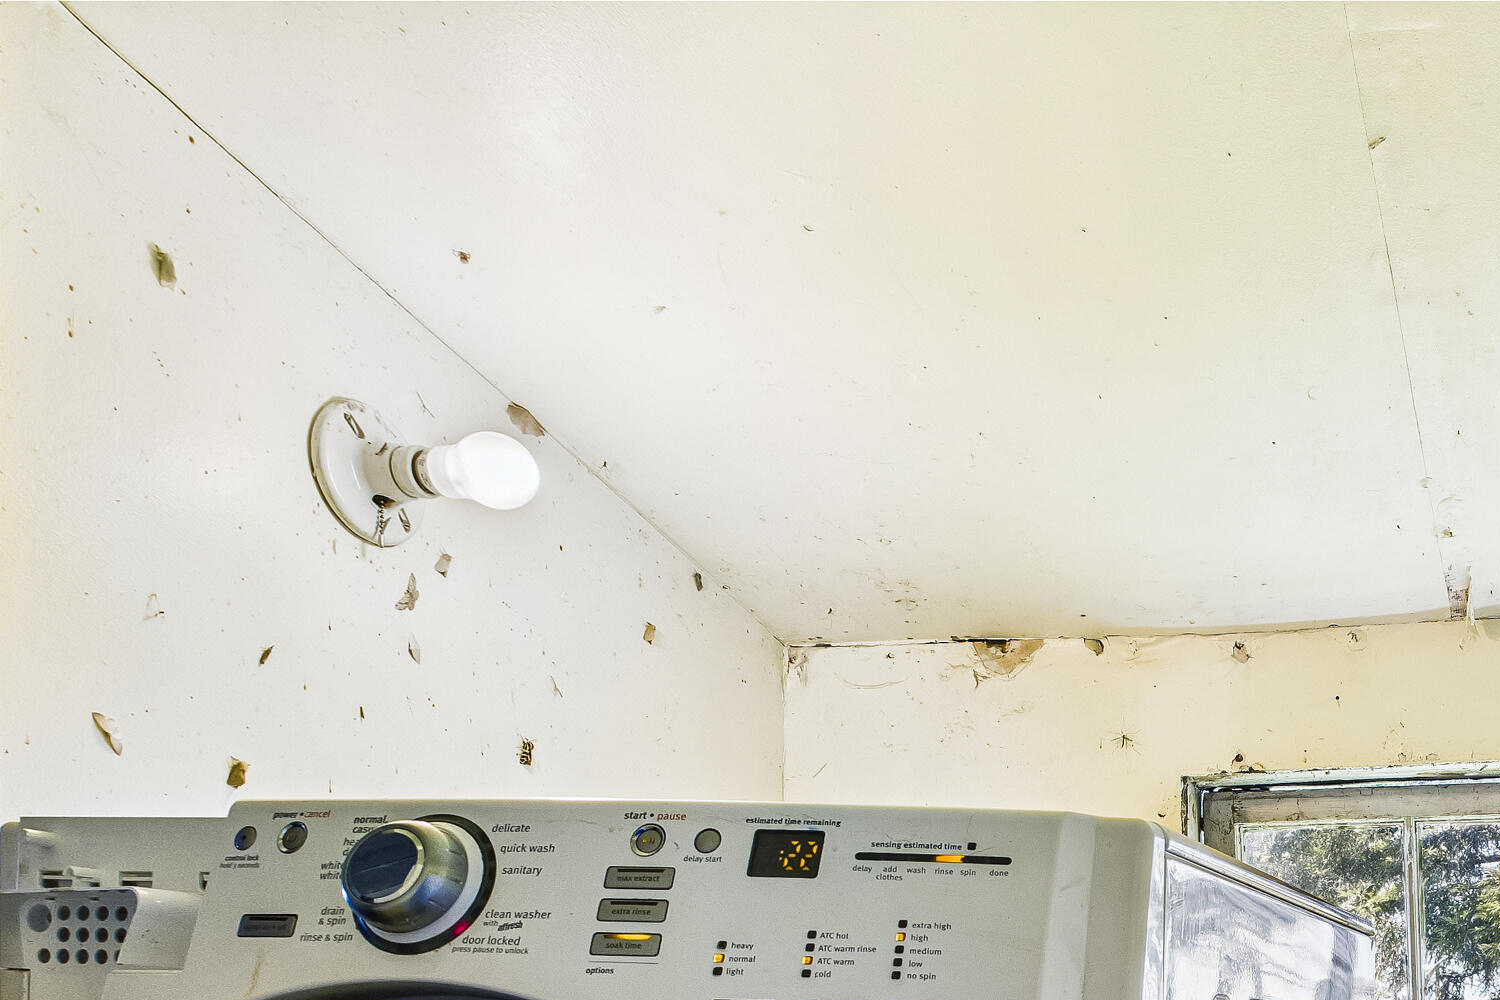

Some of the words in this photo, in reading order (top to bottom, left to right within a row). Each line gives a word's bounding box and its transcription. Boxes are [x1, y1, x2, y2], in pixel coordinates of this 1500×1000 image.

[304, 810, 331, 818] cancel
[624, 811, 647, 820] start
[657, 812, 686, 821] pause
[354, 815, 388, 824] normal
[745, 816, 783, 825] estimated
[784, 817, 802, 825] time
[803, 819, 841, 827] remaining
[492, 824, 531, 833] delicate
[500, 844, 527, 855] quick
[529, 844, 555, 853] wash
[871, 841, 902, 849] sensing
[904, 841, 943, 850] estimated
[944, 842, 962, 850] time
[683, 855, 703, 863] delay
[704, 855, 722, 863] start
[502, 866, 543, 876] sanitary
[852, 865, 873, 873] delay
[960, 868, 976, 876] spin
[321, 906, 345, 916] drain
[485, 909, 512, 919] clean
[514, 910, 552, 919] washer
[318, 917, 324, 925] &
[326, 916, 346, 927] spin
[934, 922, 952, 931] high
[300, 932, 323, 942] rinse
[333, 932, 353, 943] spin
[462, 935, 485, 944] door
[487, 936, 521, 946] locked
[911, 934, 929, 942] high
[605, 941, 623, 949] soak
[731, 941, 754, 950] heavy
[909, 947, 942, 956] medium
[728, 955, 756, 963] normal
[908, 960, 923, 968] low
[585, 967, 614, 975] options
[726, 967, 744, 976] light
[814, 970, 832, 978] cold
[919, 972, 937, 981] spin
